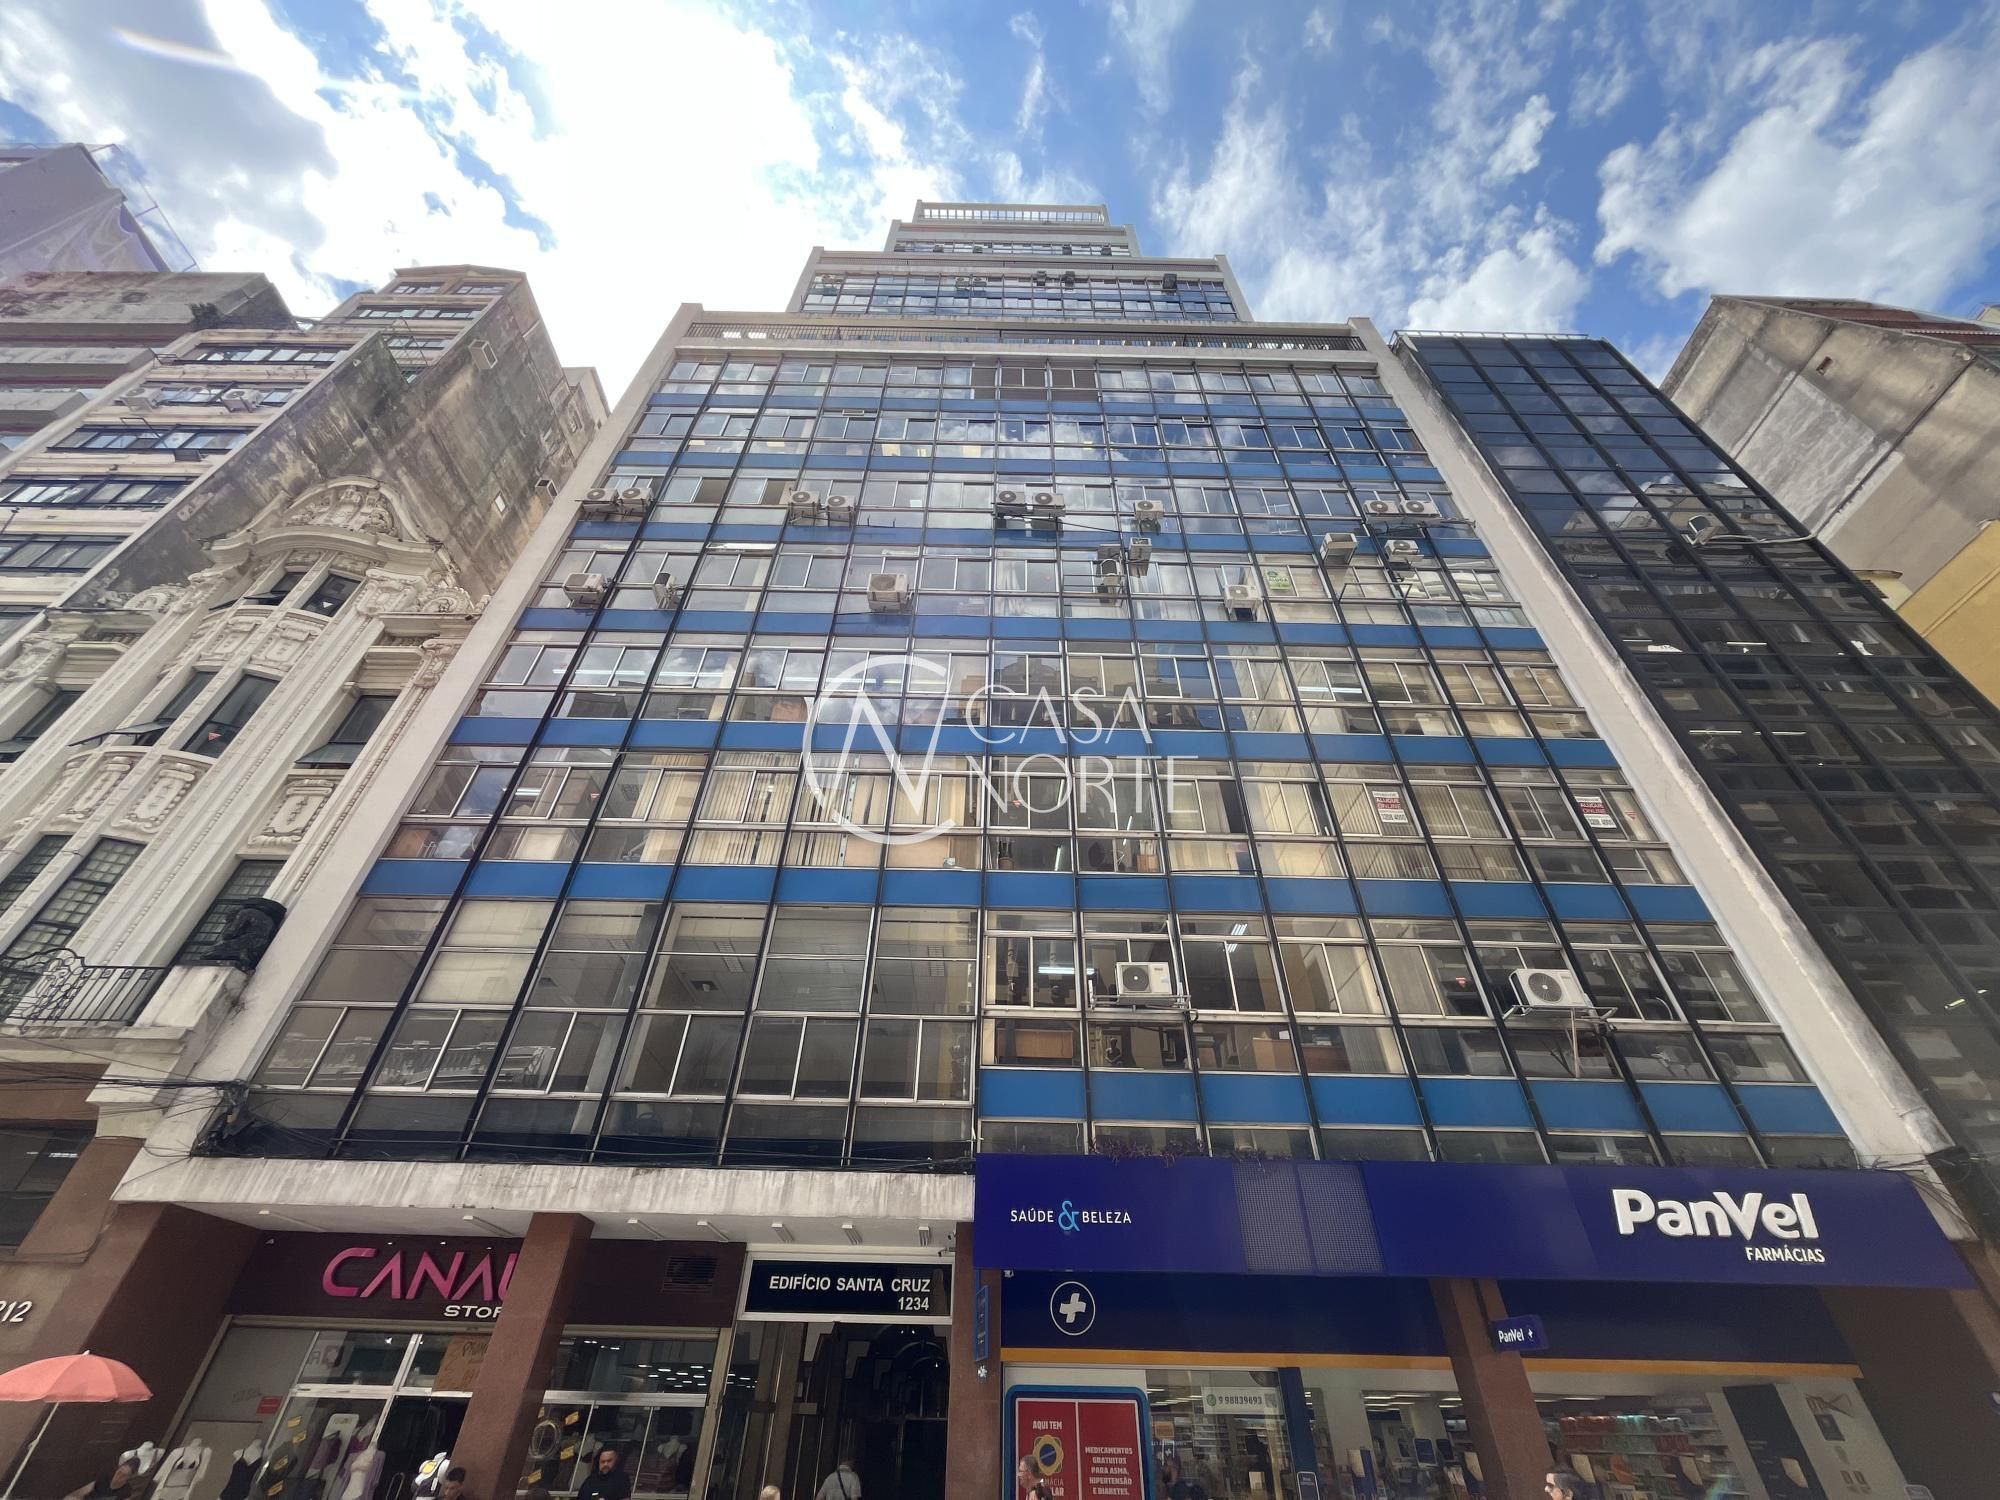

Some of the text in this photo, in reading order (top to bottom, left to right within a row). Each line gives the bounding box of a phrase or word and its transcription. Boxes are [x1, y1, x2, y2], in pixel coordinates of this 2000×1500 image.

[1010, 1200, 1132, 1231] SAÚDE & BELEZA
[1612, 1188, 1819, 1241] PanVel
[1745, 1244, 1825, 1263] FARMÁCIAS
[769, 1273, 931, 1292] EDIFÍCIO SANTA CRUZ
[898, 1297, 930, 1311] 1234
[1498, 1328, 1525, 1343] PanVel
[1032, 1420, 1063, 1430] AQUI TEM
[1085, 1446, 1133, 1455] MEDICAMENTOS
[1092, 1456, 1127, 1465] GRATUITOS
[1091, 1466, 1130, 1476] PARA ASMA,
[1089, 1476, 1133, 1486] HIPERTENSÃO
[1092, 1487, 1098, 1495] E
